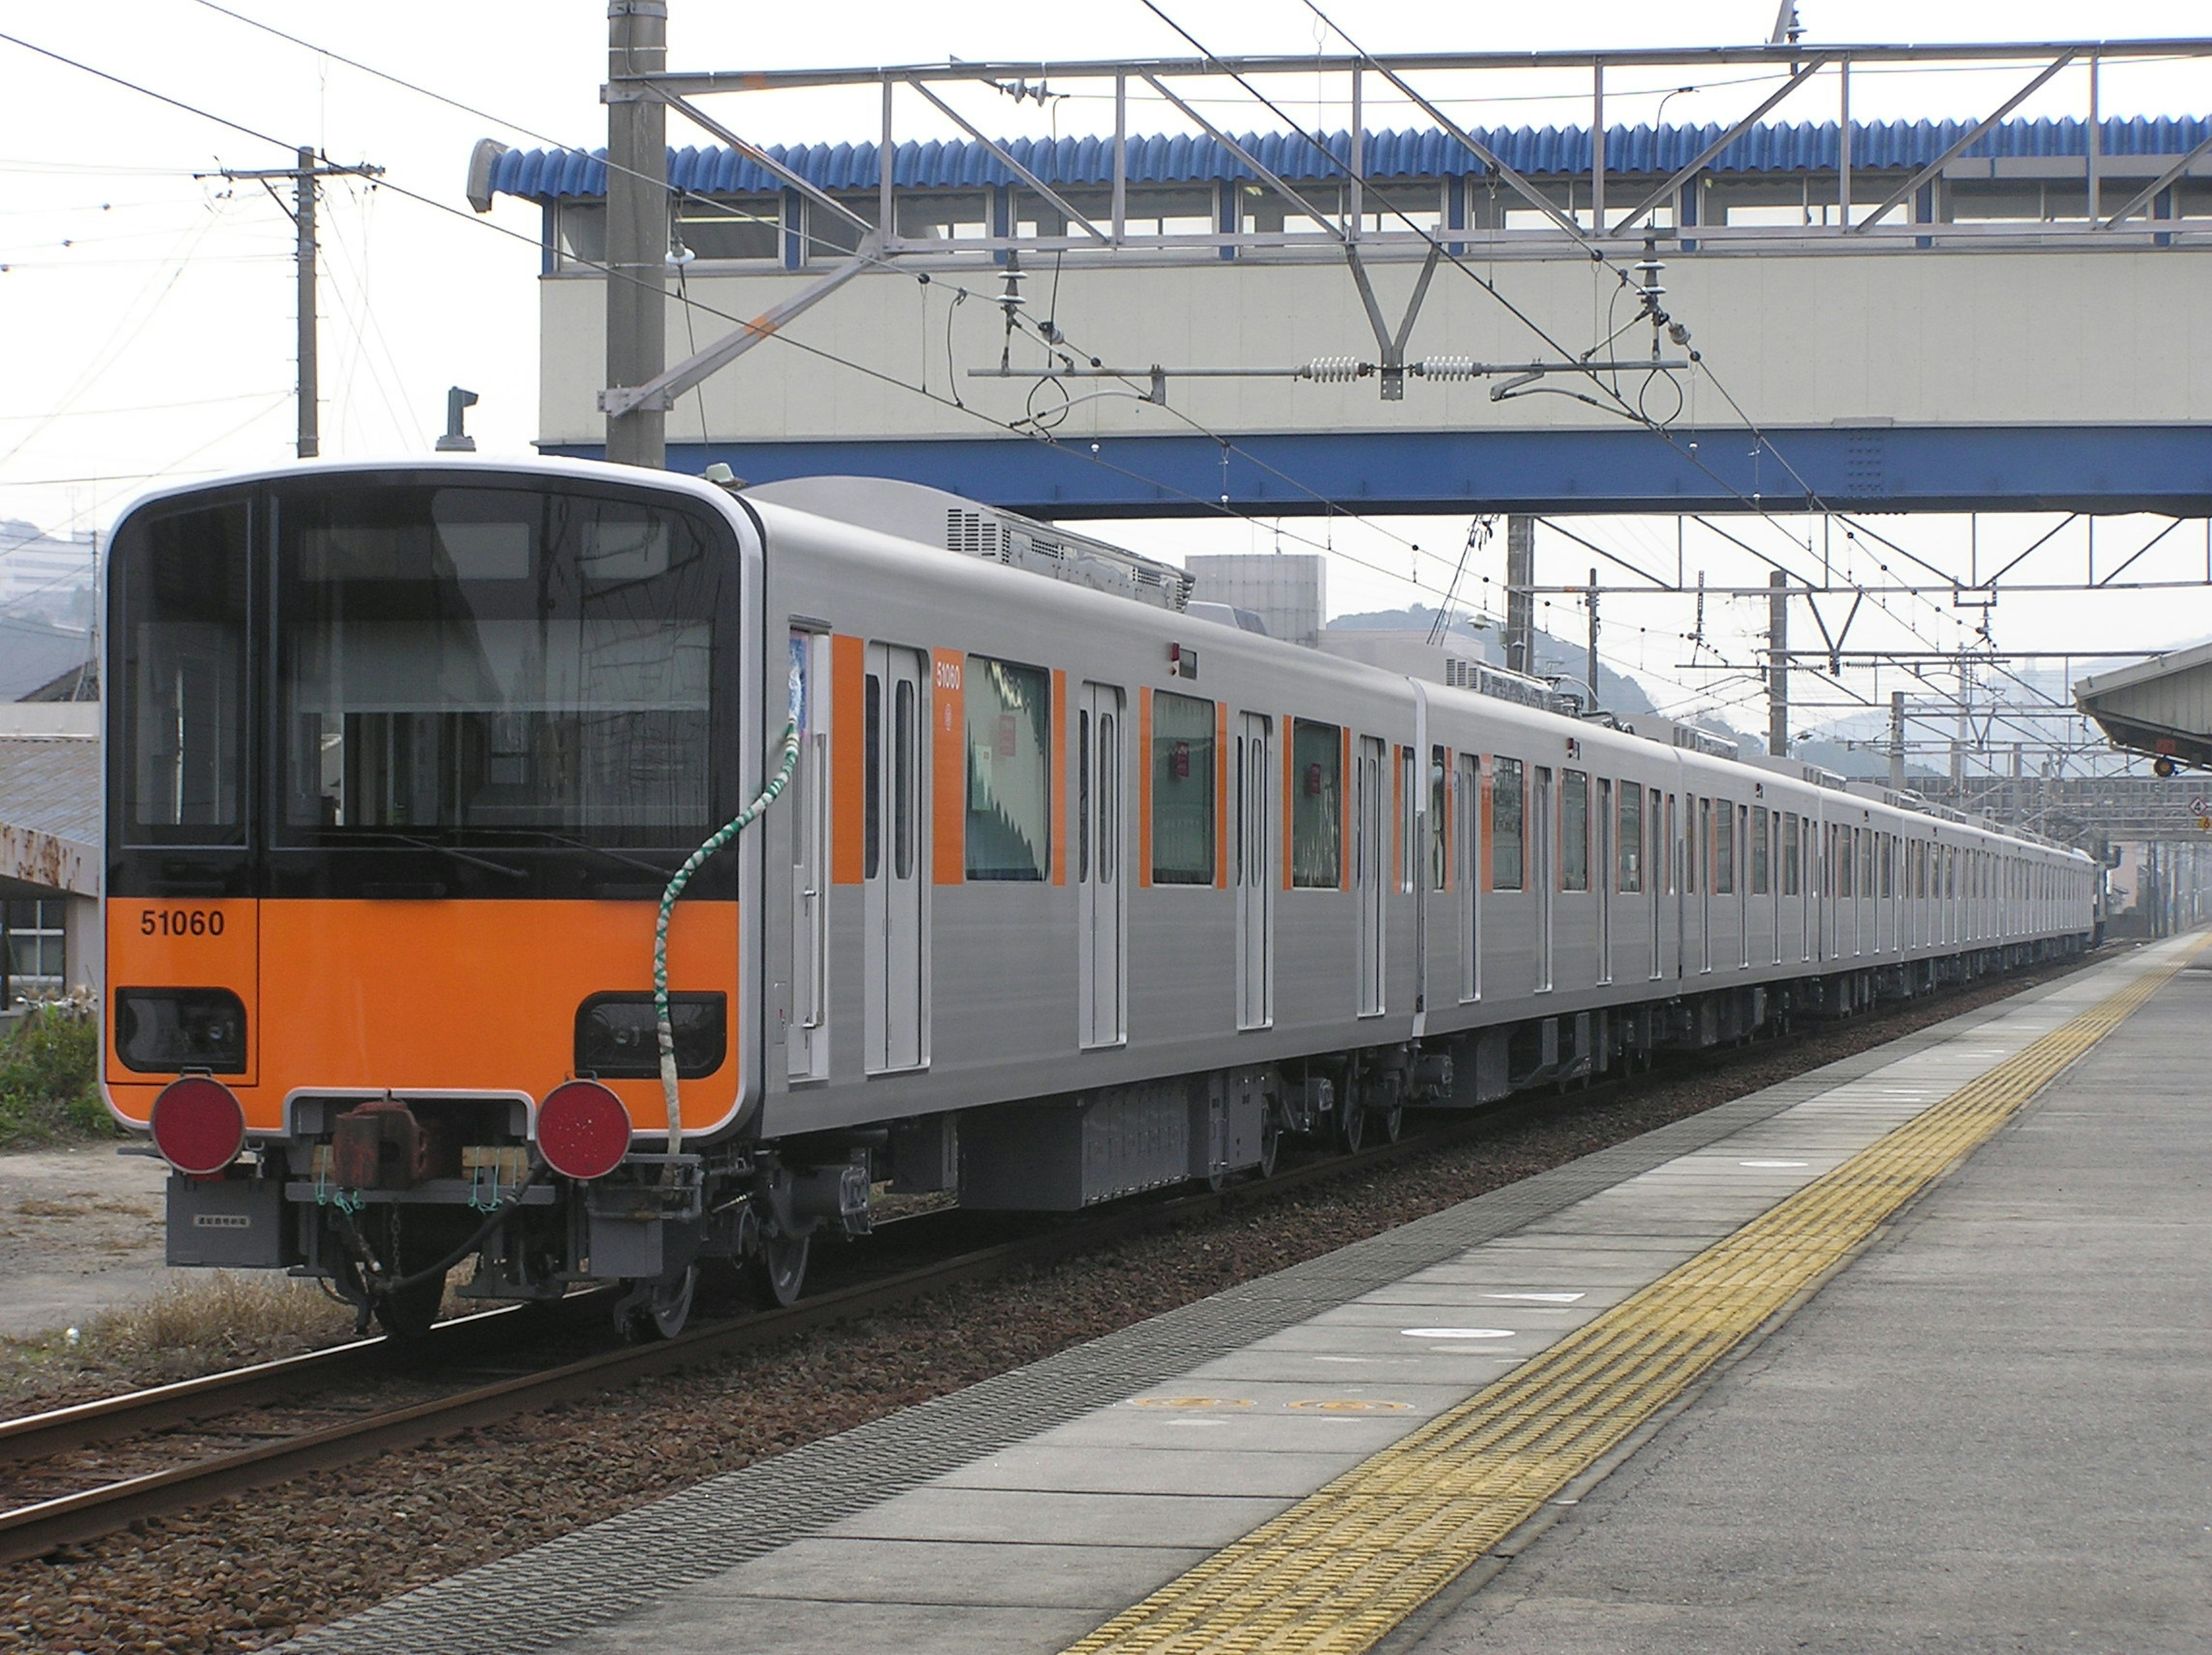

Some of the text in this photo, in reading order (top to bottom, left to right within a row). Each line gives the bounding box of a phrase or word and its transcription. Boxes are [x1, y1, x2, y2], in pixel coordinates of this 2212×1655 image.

[937, 661, 960, 690] 51060
[2194, 801, 2202, 811] 4
[141, 910, 225, 936] 51060
